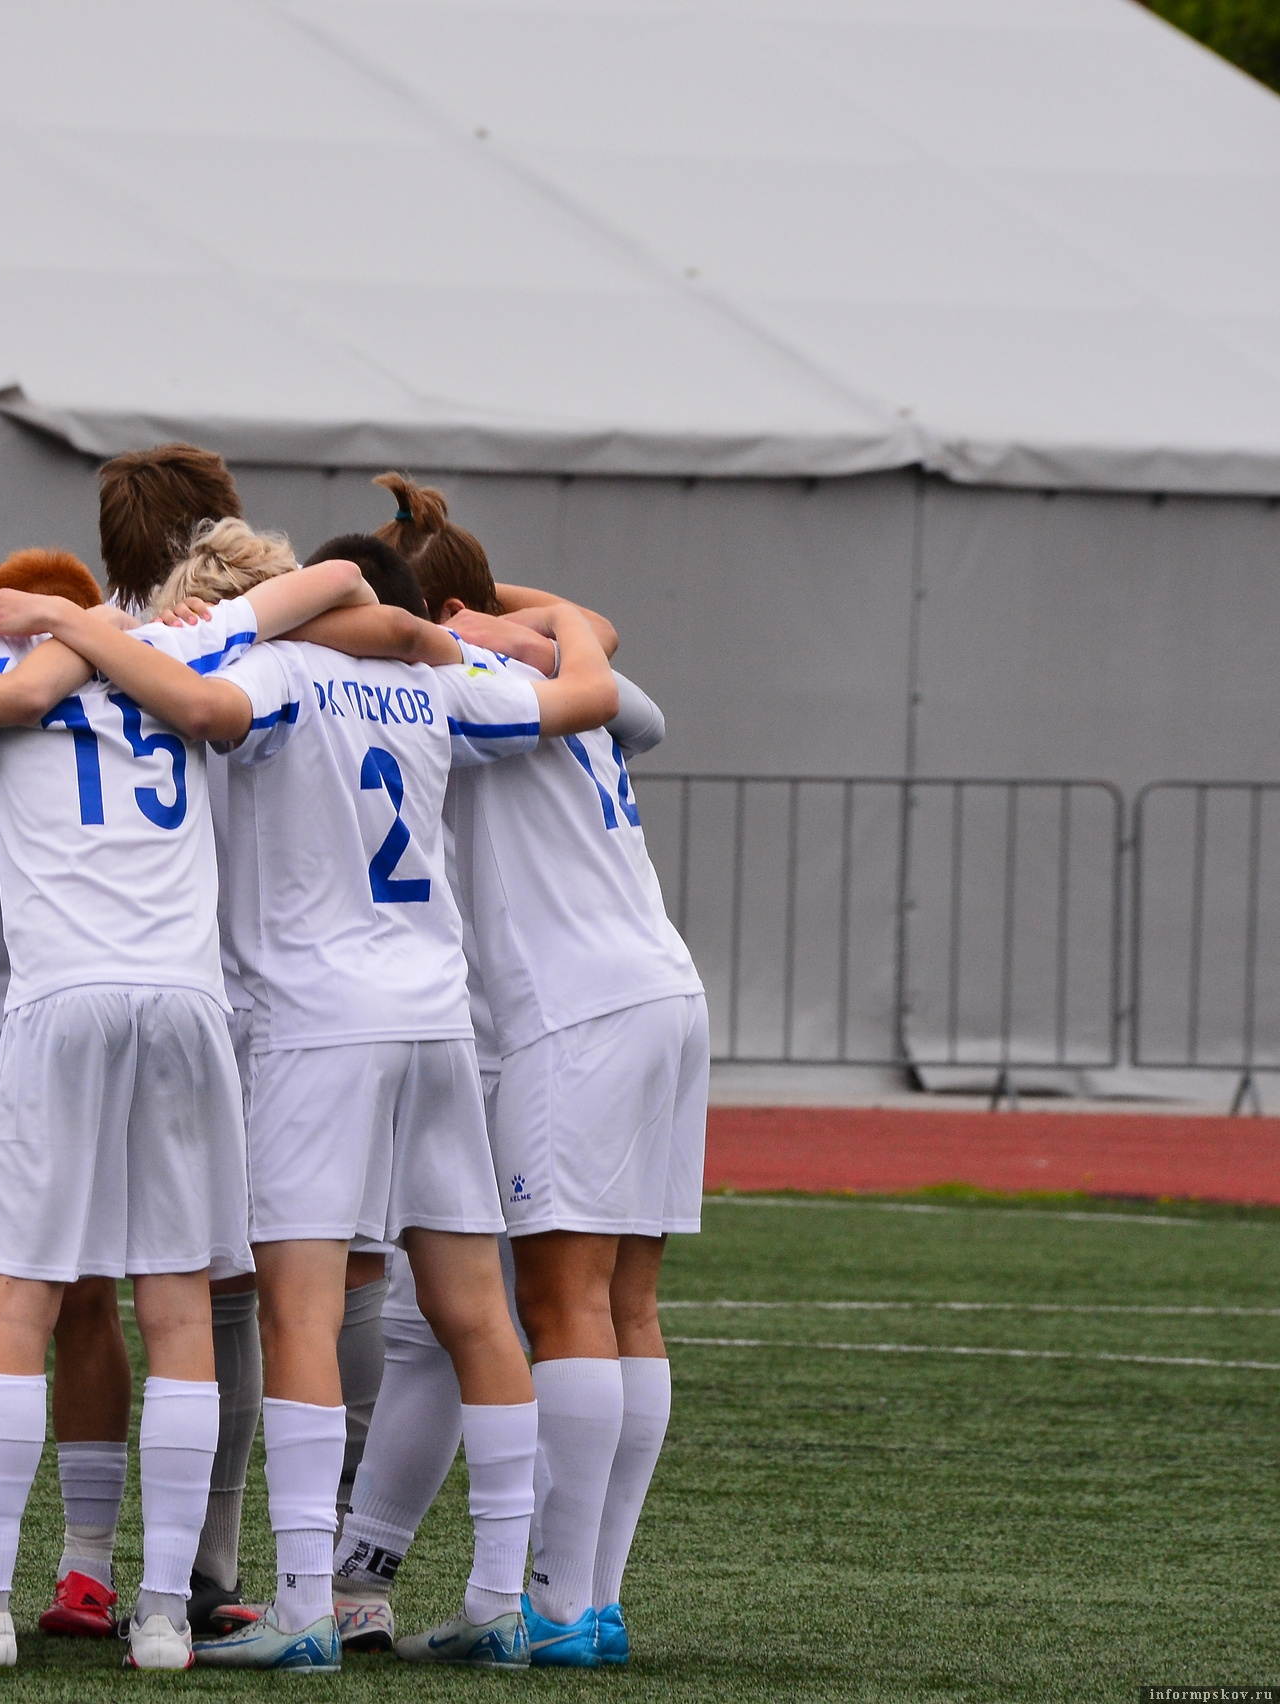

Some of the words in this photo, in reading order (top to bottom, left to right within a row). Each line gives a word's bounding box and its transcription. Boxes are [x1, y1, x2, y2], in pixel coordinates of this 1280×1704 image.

[41, 692, 188, 831] 15
[342, 680, 434, 726] ПСКОВ
[359, 746, 432, 903] 2
